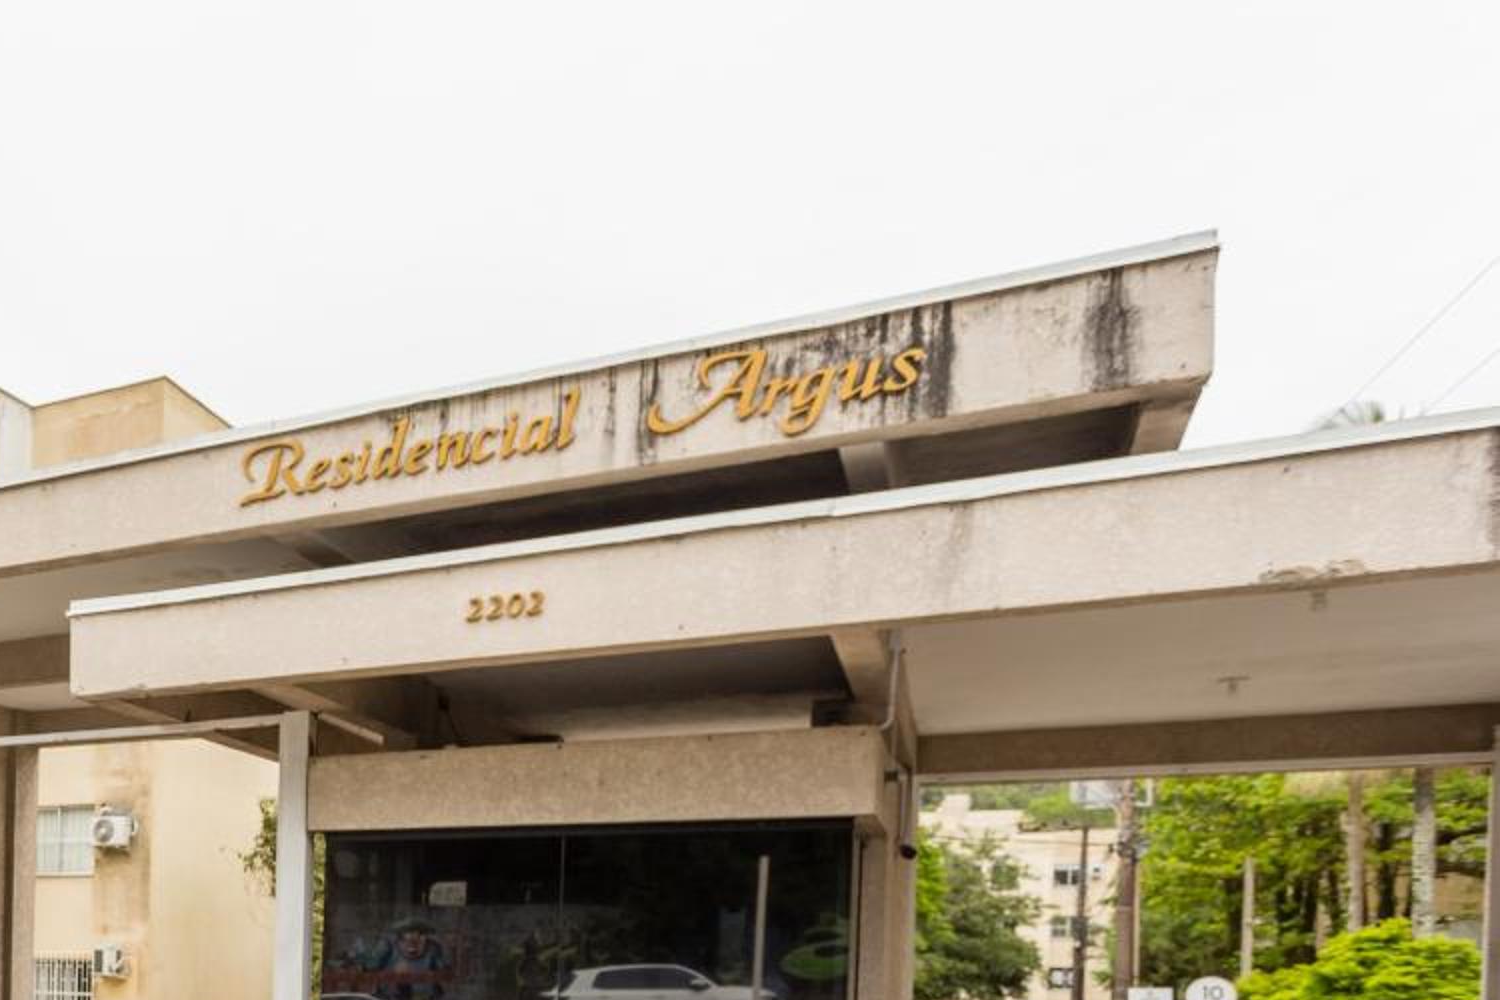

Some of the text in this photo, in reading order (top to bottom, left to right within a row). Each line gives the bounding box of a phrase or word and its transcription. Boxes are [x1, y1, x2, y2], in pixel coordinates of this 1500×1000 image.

[240, 345, 926, 507] Residencial Argus
[1202, 984, 1224, 1000] 10
